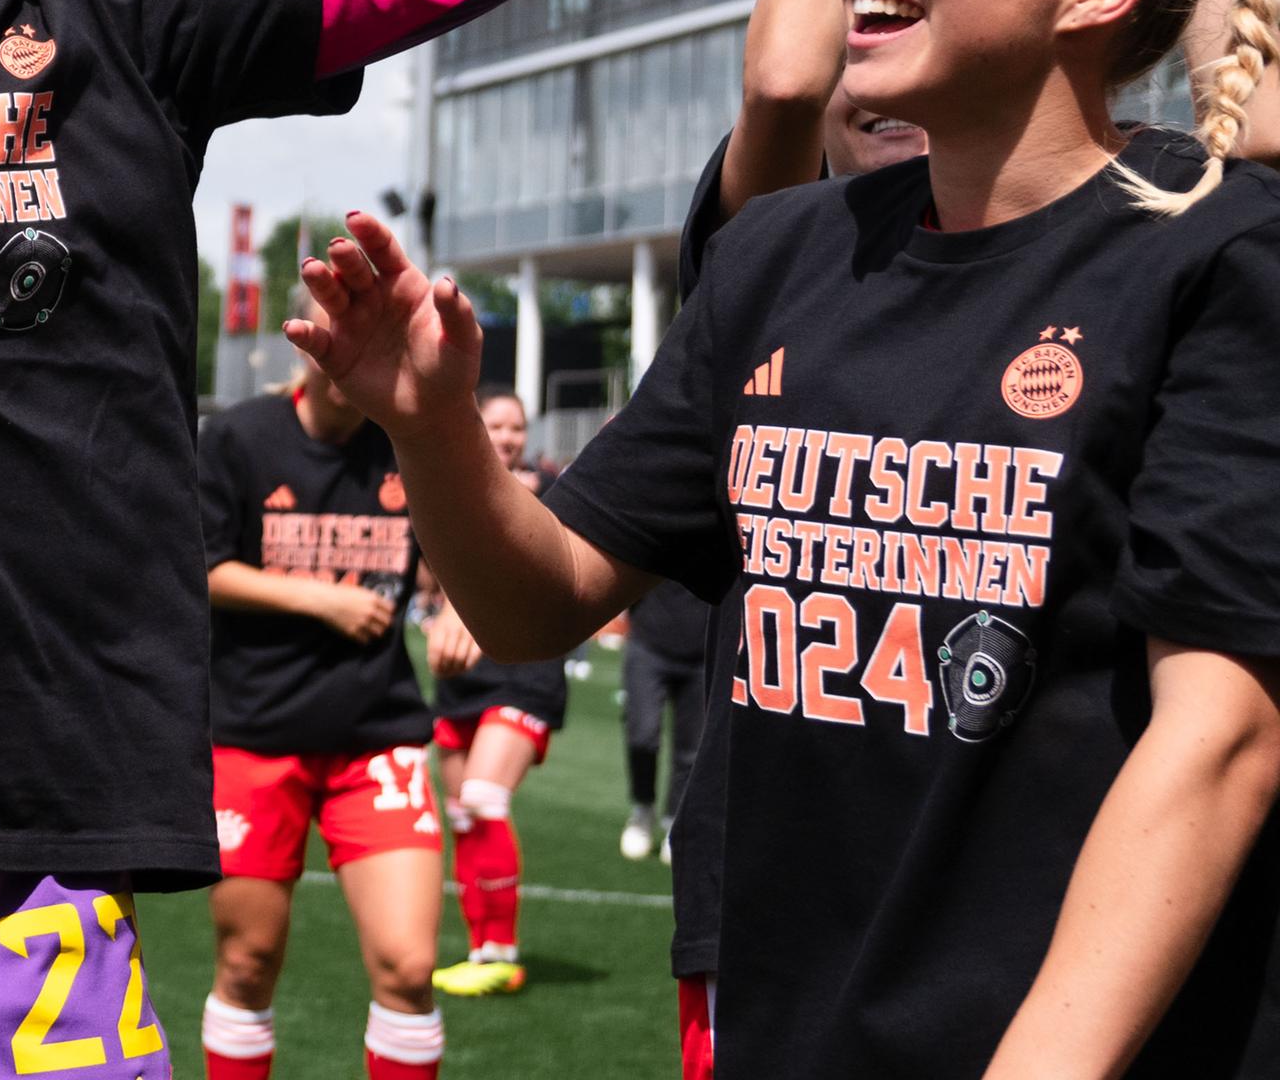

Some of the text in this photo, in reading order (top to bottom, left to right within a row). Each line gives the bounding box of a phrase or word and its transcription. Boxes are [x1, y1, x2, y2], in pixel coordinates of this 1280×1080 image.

[727, 424, 1064, 539] DEUTSCHE
[736, 513, 1050, 608] EISTERINNEN
[367, 746, 429, 811] 17
